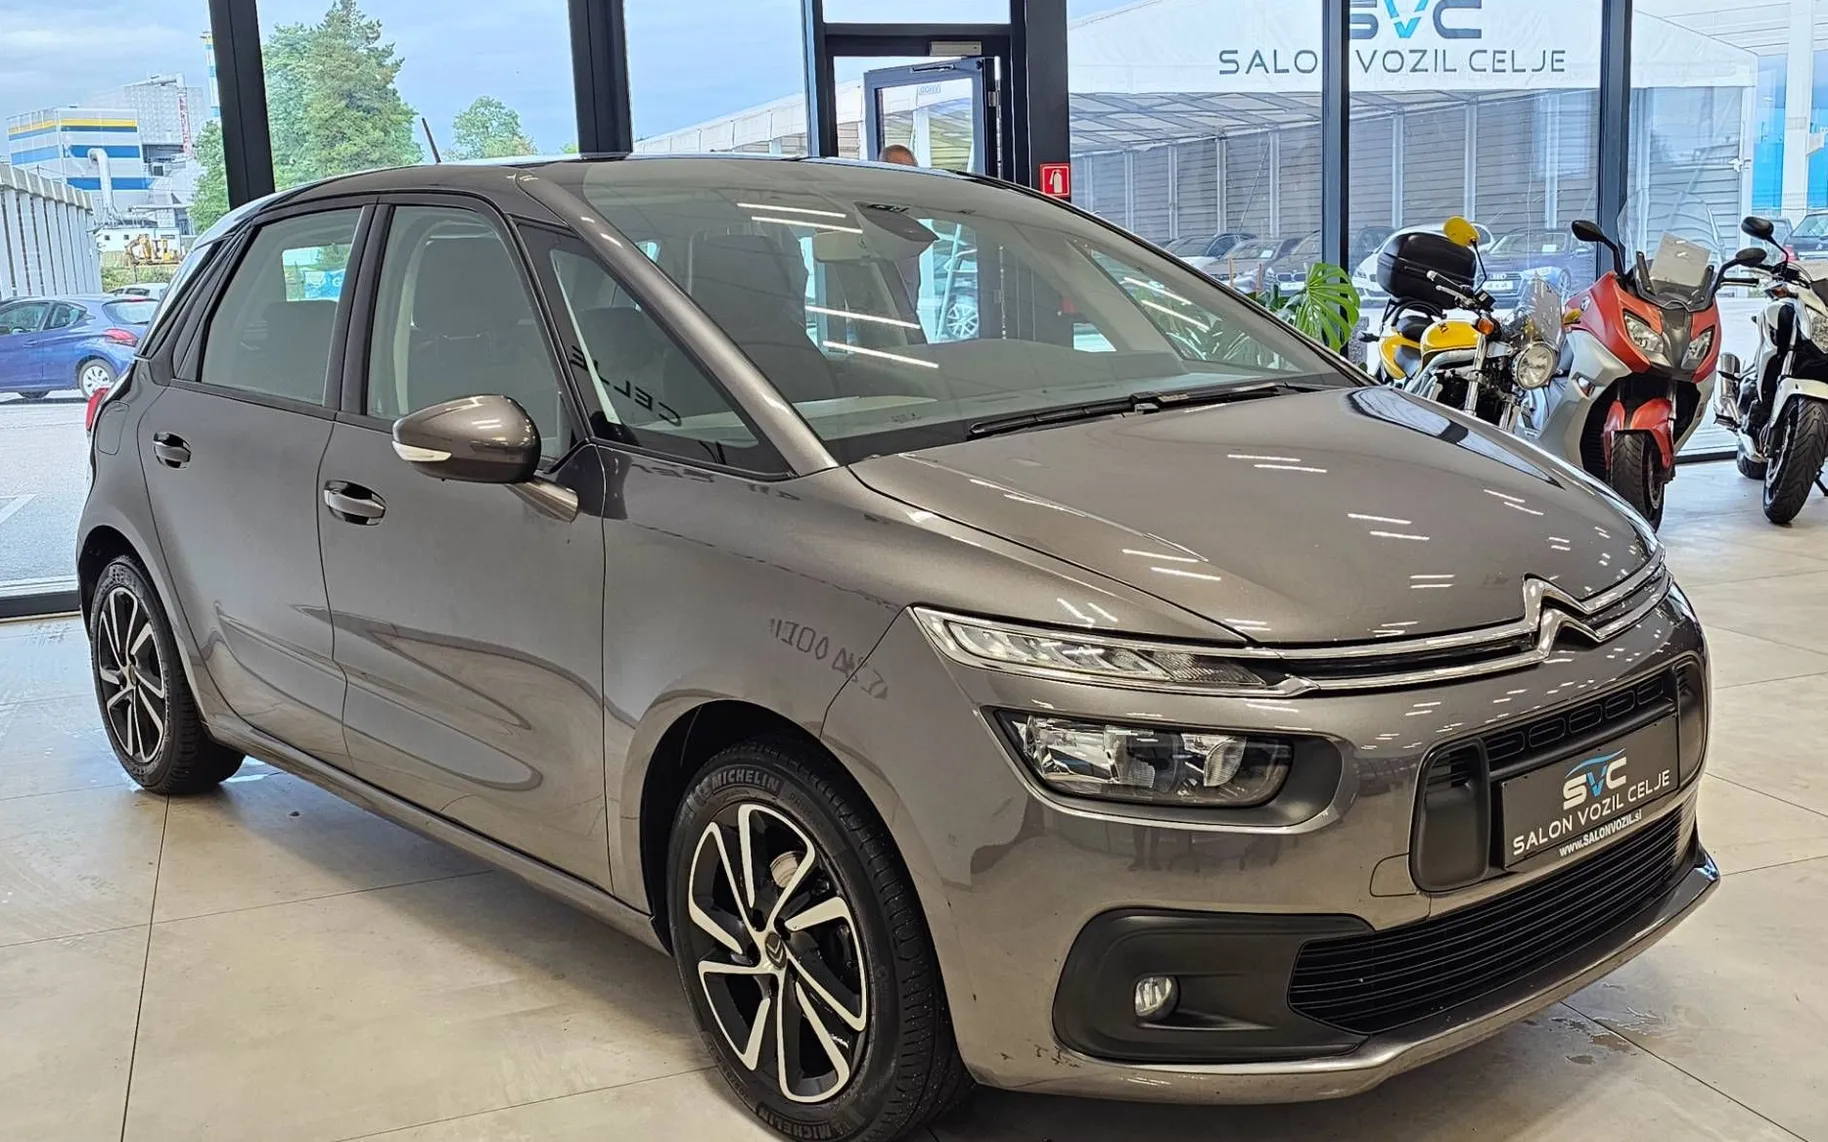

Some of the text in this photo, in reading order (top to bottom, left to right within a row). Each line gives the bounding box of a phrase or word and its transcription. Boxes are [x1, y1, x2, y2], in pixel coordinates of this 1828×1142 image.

[1219, 49, 1566, 75] SALO VOZIL CELJE
[711, 768, 780, 794] MICHELIN
[1563, 757, 1627, 810] SVC
[1513, 769, 1670, 856] SALON VOZIL CELJE
